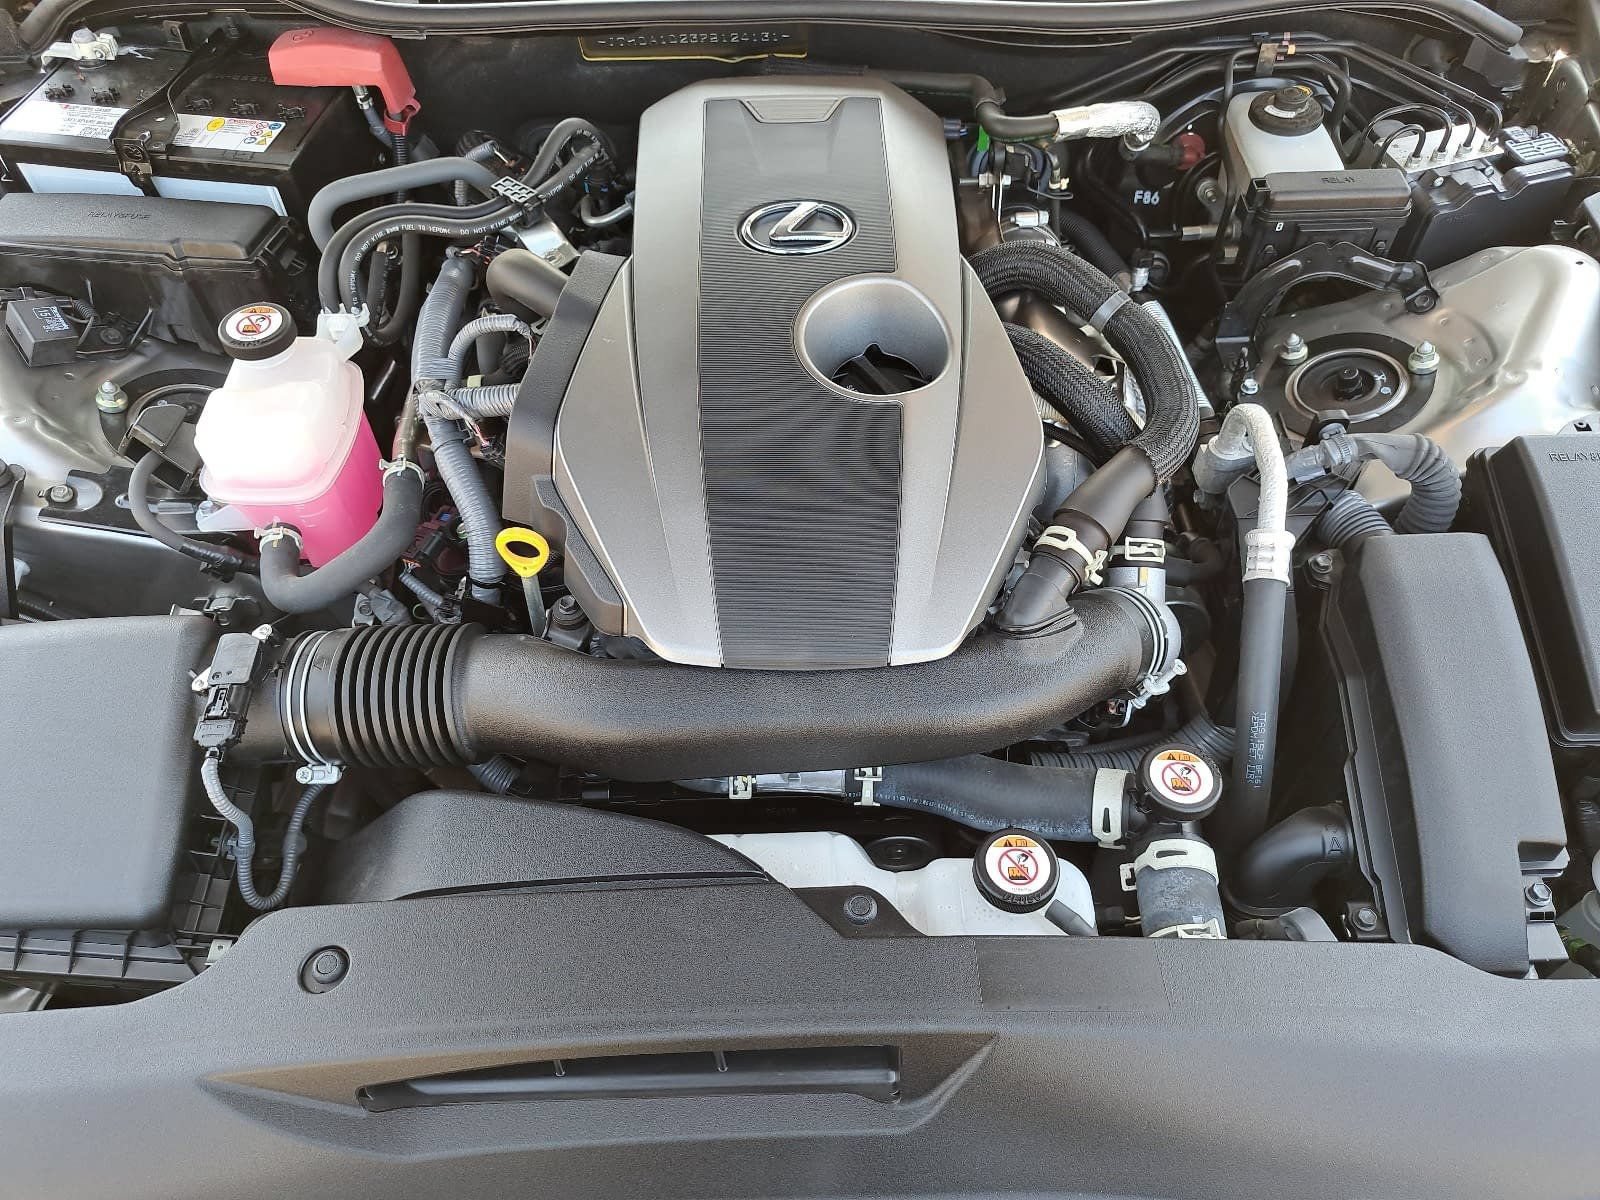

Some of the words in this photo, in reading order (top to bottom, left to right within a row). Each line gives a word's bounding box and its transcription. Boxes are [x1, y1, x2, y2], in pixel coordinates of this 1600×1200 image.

[1320, 176, 1356, 184] RELAY
[1133, 189, 1160, 206] F86
[459, 228, 470, 236] DO
[473, 226, 488, 235] NOT
